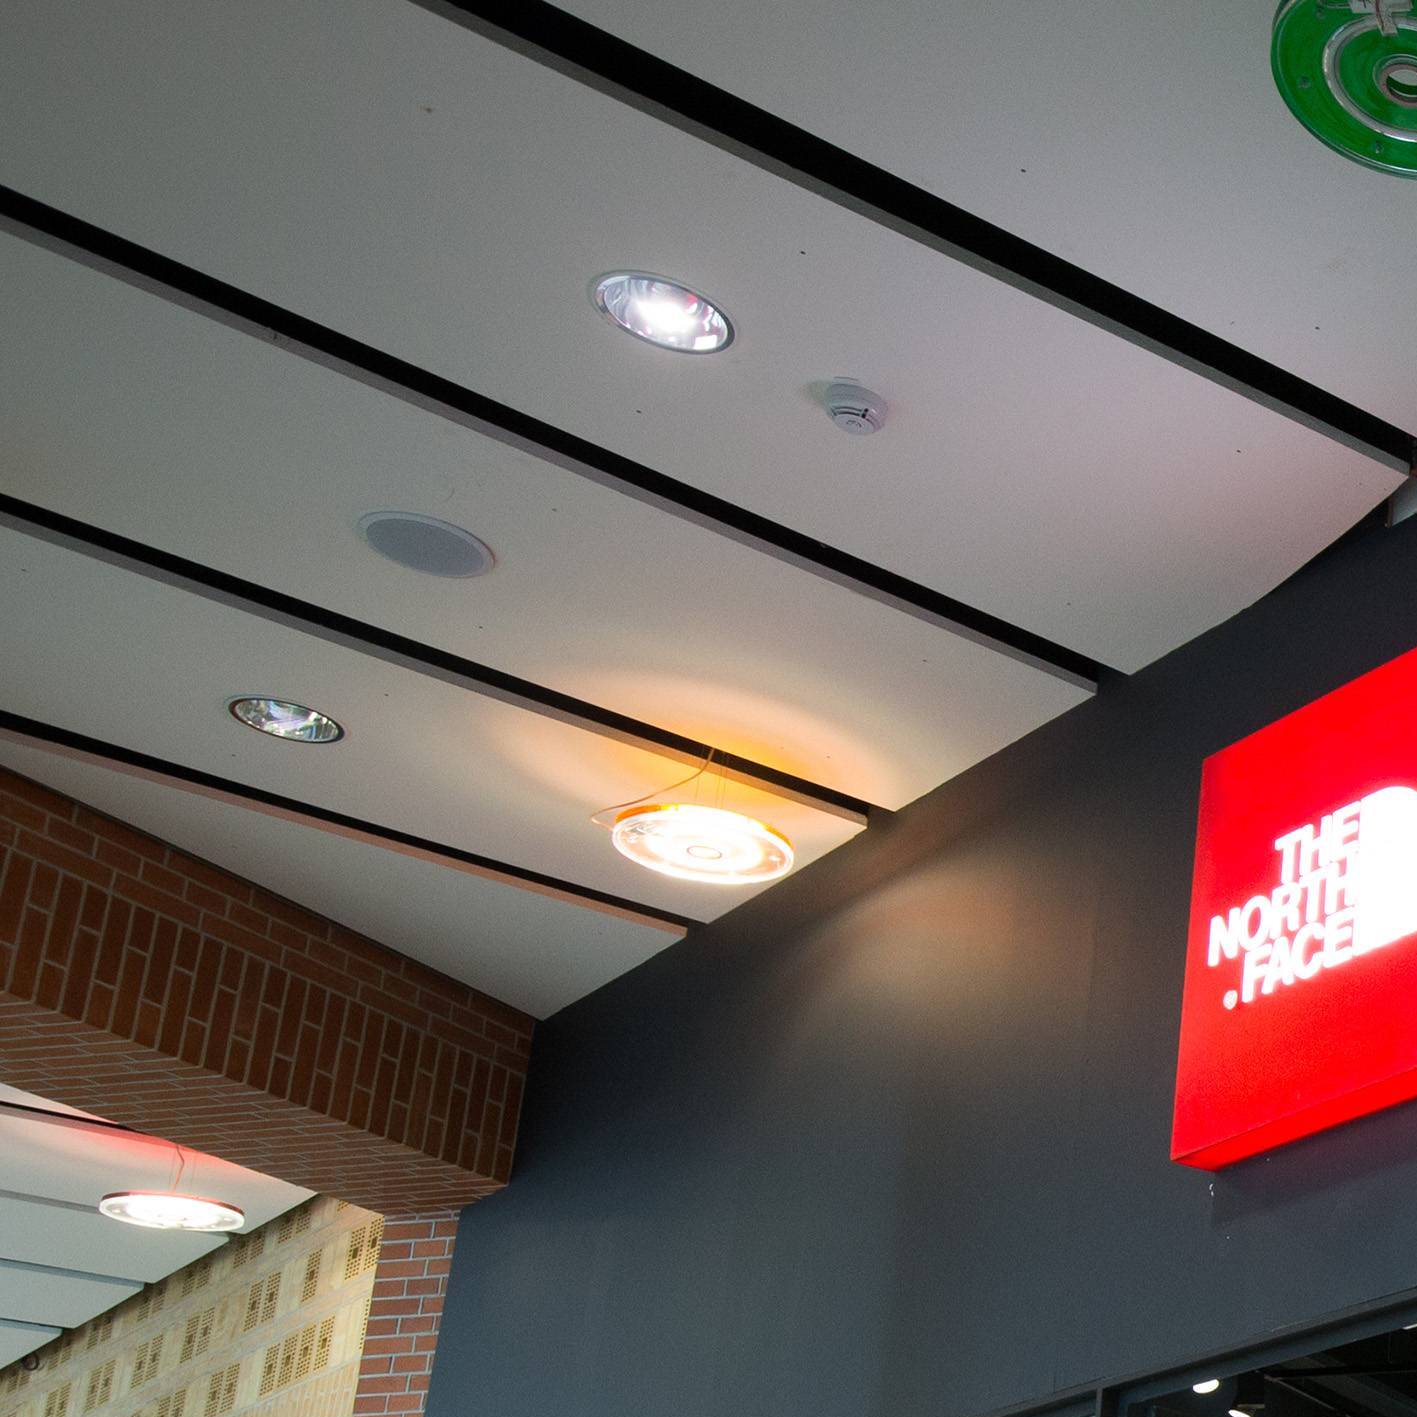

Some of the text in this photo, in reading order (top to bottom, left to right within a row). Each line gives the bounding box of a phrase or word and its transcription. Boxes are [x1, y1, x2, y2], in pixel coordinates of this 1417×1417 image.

[1274, 800, 1361, 885] THE
[1207, 861, 1359, 967] NORTH
[1241, 906, 1355, 1003] FACE
